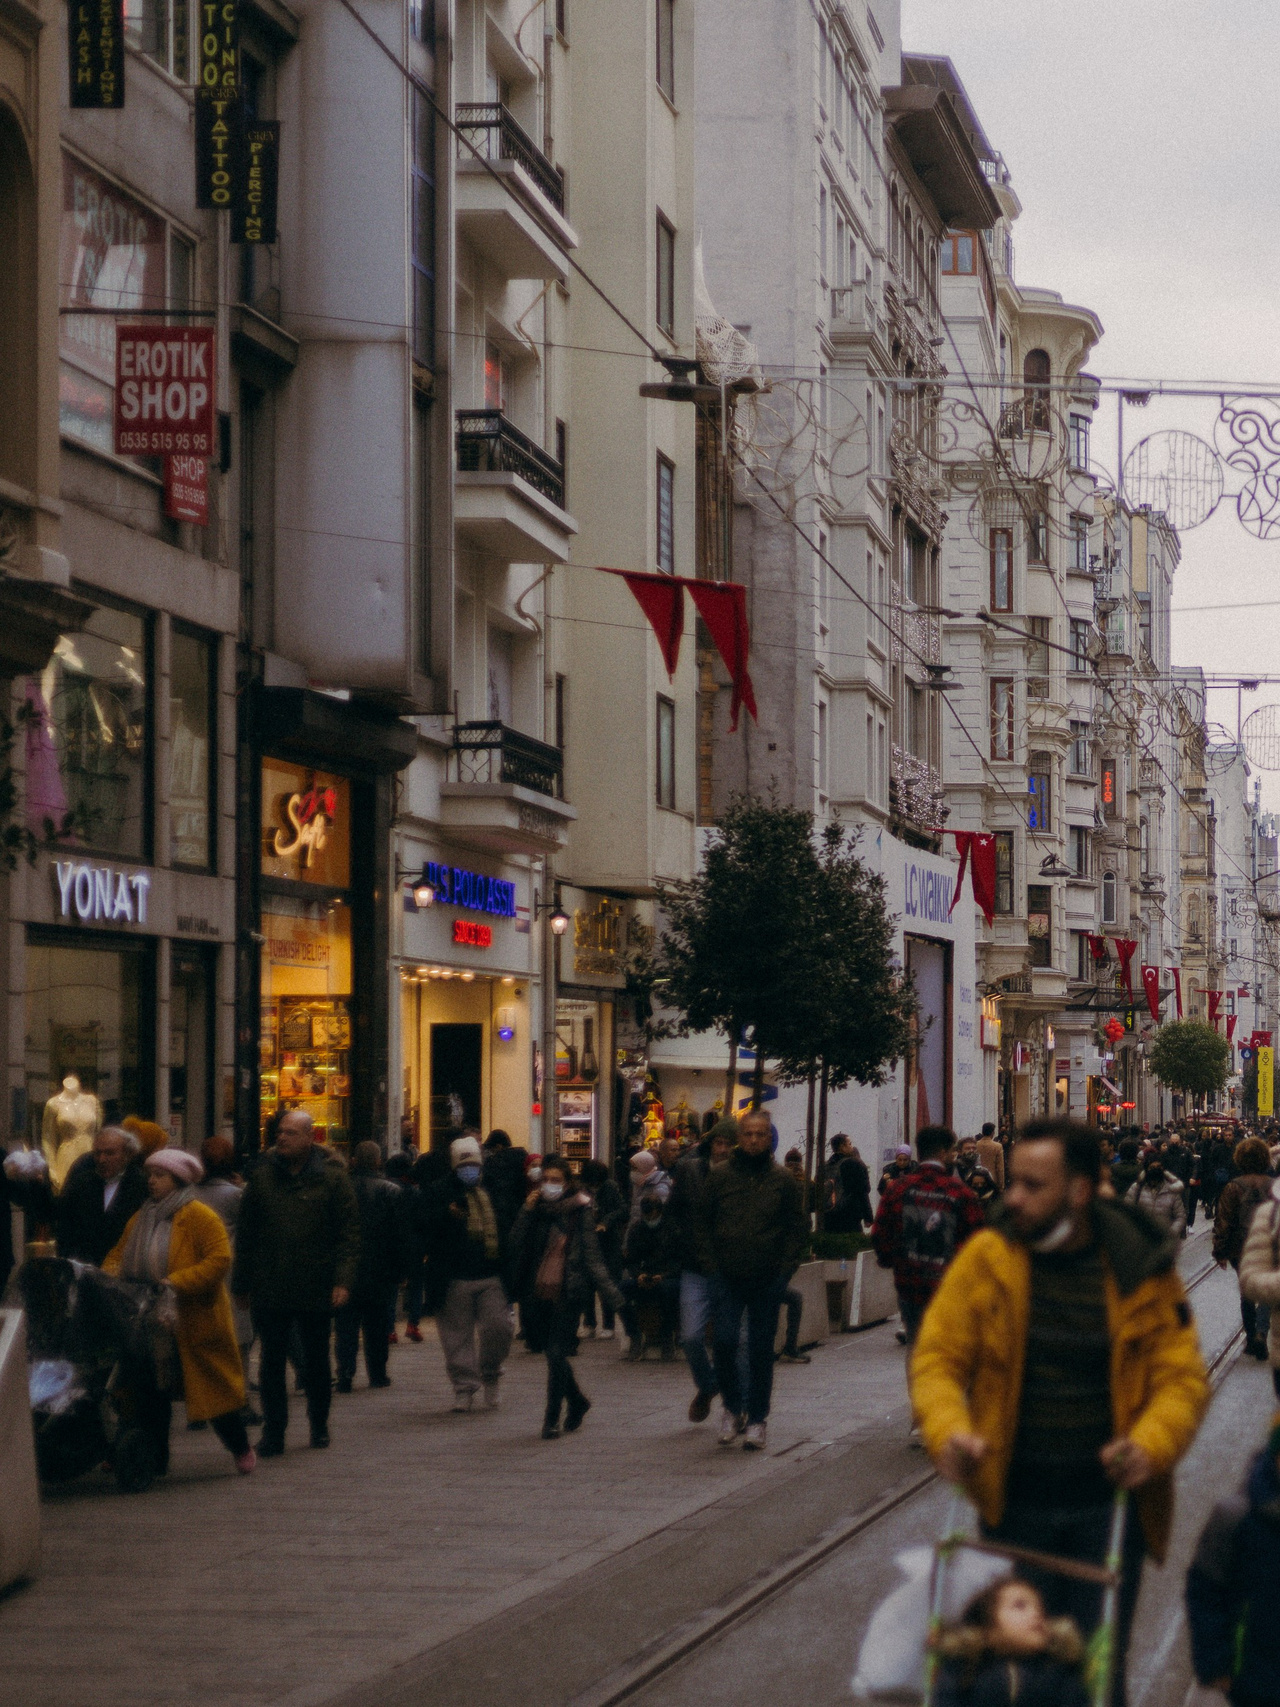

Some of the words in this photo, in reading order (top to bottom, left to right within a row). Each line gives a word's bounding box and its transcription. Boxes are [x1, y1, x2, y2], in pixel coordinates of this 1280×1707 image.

[77, 6, 91, 84] LASH
[100, 0, 115, 103] XTENSIONS
[211, 101, 230, 203] TATTOO
[245, 142, 264, 240] PIERCING
[120, 333, 207, 377] EROTİK
[120, 381, 208, 420] SHOP
[120, 431, 148, 449] 0535
[152, 432, 173, 450] 515
[176, 433, 190, 450] 95
[193, 434, 207, 451] 95
[172, 454, 205, 481] SHOP
[56, 862, 150, 923] YONAT
[453, 867, 485, 911] POLO
[905, 862, 918, 918] LC
[269, 938, 299, 959] TURKISH
[302, 942, 331, 962] DELIGHT
